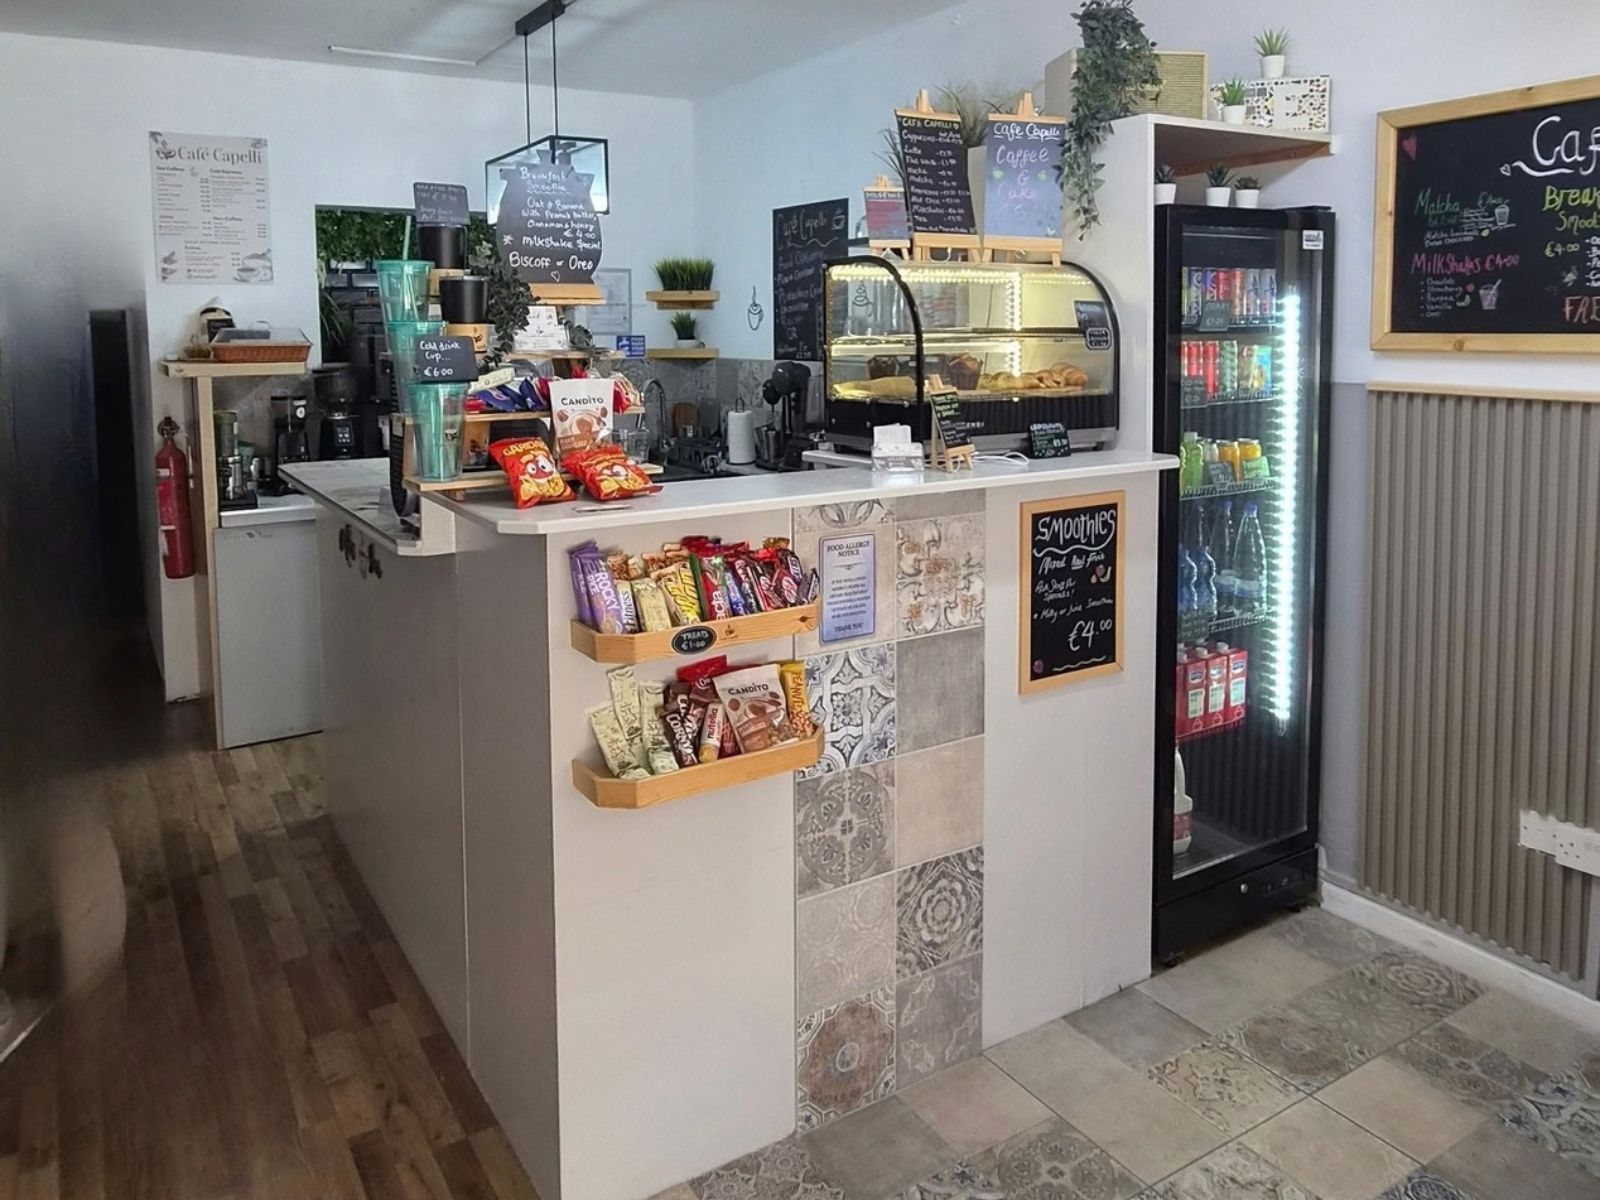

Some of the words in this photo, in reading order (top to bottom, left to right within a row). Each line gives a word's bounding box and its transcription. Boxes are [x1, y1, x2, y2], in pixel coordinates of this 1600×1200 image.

[1025, 123, 1060, 141] Capelli
[177, 146, 210, 161] Café
[213, 148, 263, 165] Capelli
[996, 145, 1049, 168] Coffee
[527, 196, 544, 208] Oat
[555, 200, 584, 210] Banana
[1413, 187, 1460, 216] Matcha
[568, 254, 594, 270] Oreo
[826, 543, 845, 552] FOOD
[595, 571, 621, 610] ROCKY
[1067, 618, 1112, 651] €4.00
[708, 707, 720, 740] nutella
